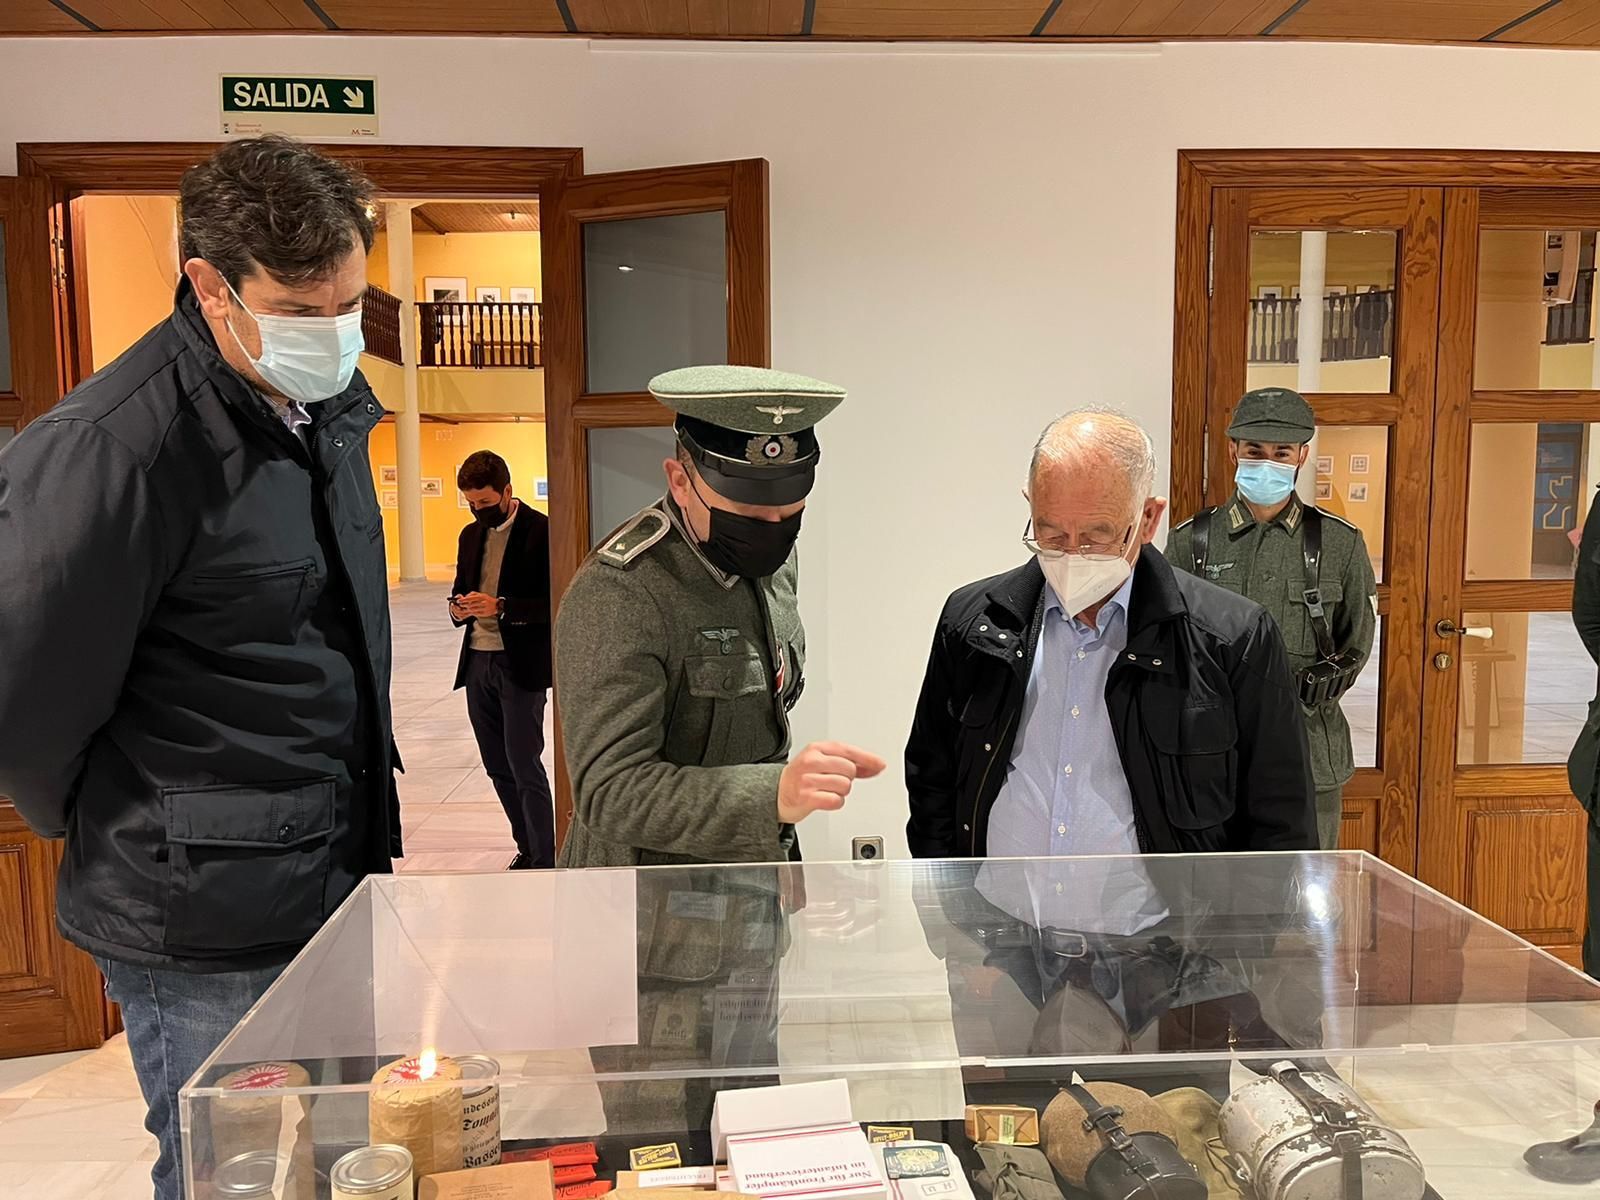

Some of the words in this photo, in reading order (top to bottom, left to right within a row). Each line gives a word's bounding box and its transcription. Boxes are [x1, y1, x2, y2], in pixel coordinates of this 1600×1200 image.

[233, 81, 330, 108] SALIDA
[745, 1164, 848, 1180] Infanterieverband
[828, 1173, 846, 1182] für
[849, 1170, 872, 1178] Nur
[745, 1175, 826, 1189] Frontkämpfer
